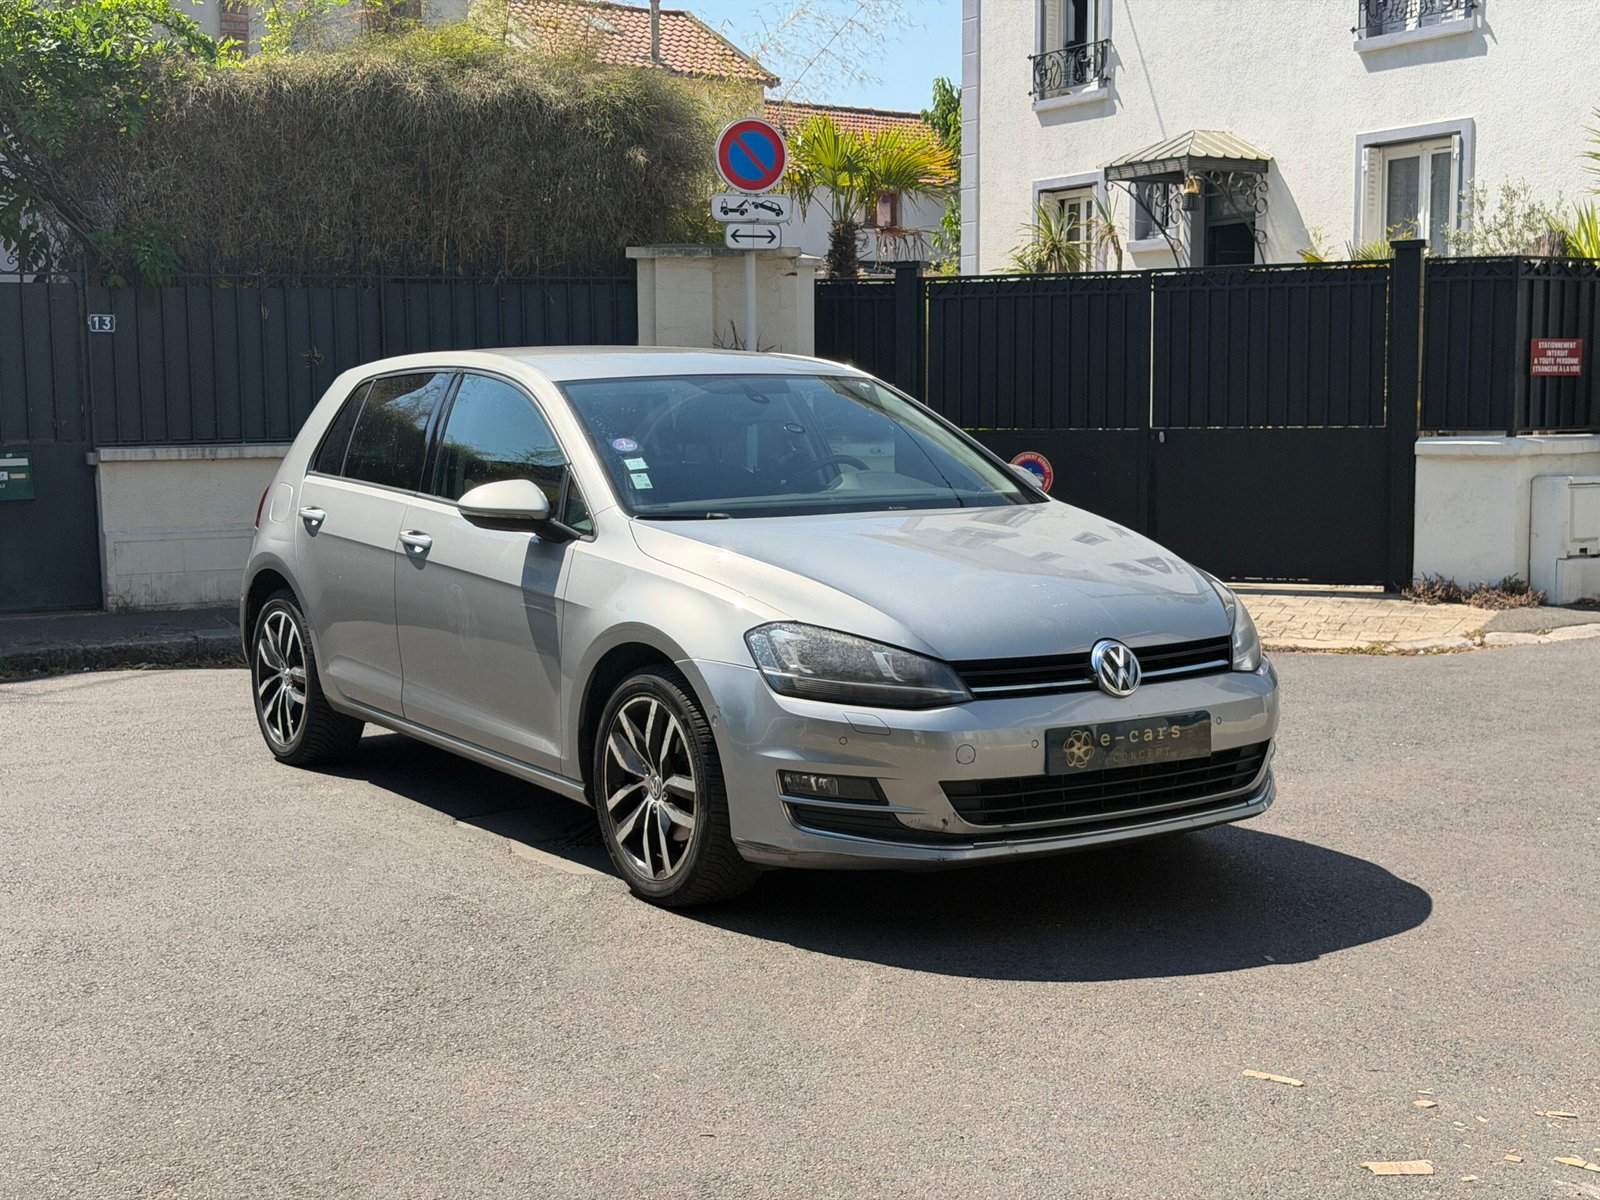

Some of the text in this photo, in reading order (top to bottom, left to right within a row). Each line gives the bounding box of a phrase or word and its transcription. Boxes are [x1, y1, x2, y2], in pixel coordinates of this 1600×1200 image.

[93, 316, 111, 330] 13
[1538, 341, 1576, 349] STATIONNEMENT
[1539, 357, 1555, 365] TOUTE
[1098, 644, 1138, 694] VW
[1100, 725, 1181, 747] e-cars
